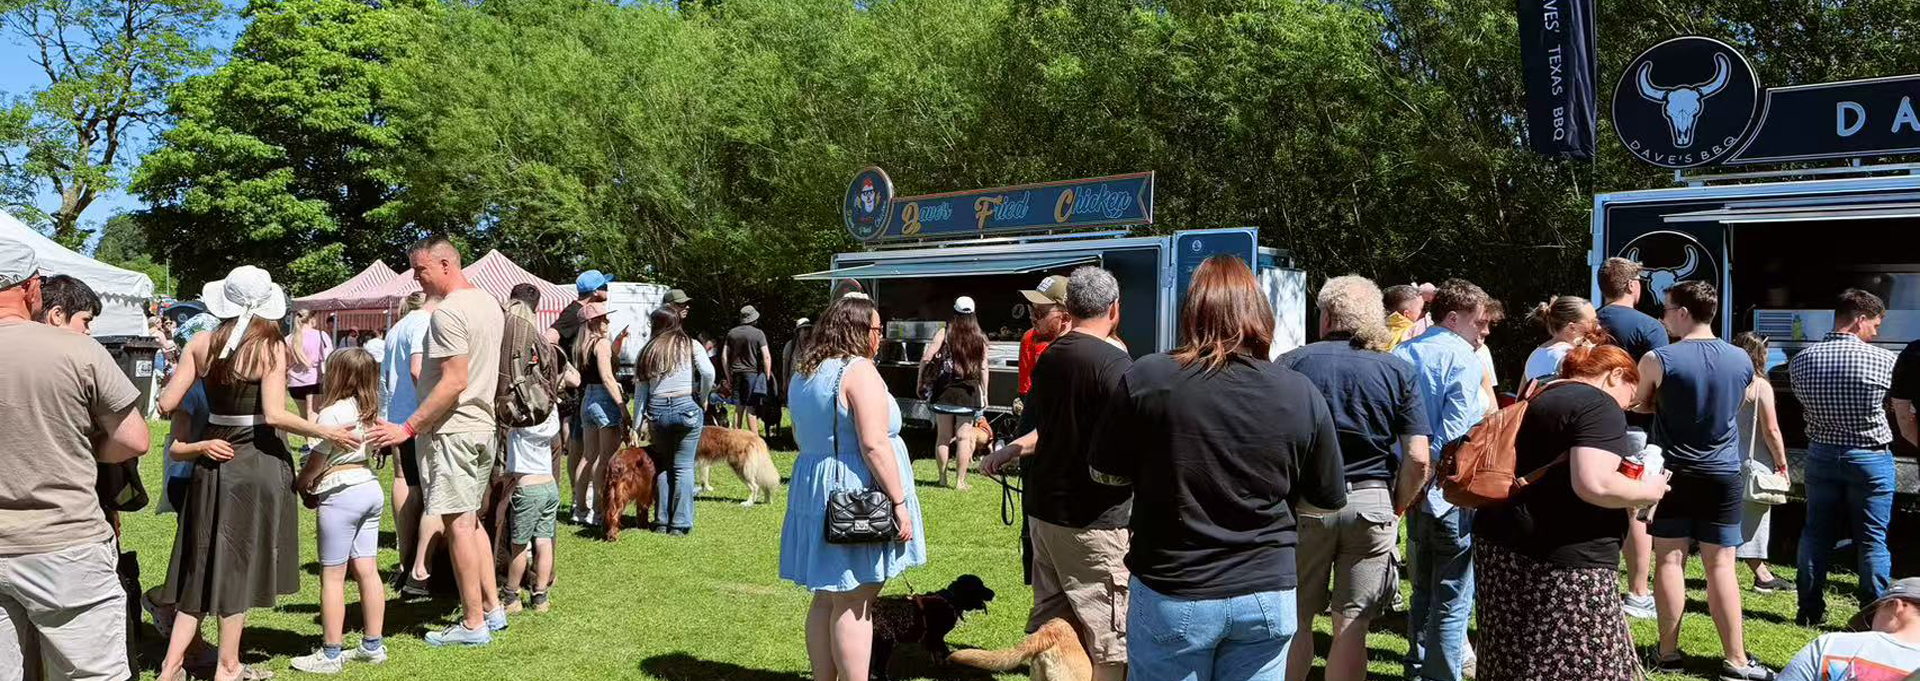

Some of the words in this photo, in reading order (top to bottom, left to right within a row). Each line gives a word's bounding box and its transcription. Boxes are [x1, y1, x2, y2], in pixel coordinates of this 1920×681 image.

[1543, 0, 1560, 33] VES'
[1548, 44, 1563, 96] TEXAS
[1553, 106, 1565, 142] BBQ
[1630, 140, 1693, 165] DAVE'S
[1700, 136, 1736, 160] BBQ
[973, 190, 1030, 232] Fried
[1054, 183, 1133, 223] Chicken
